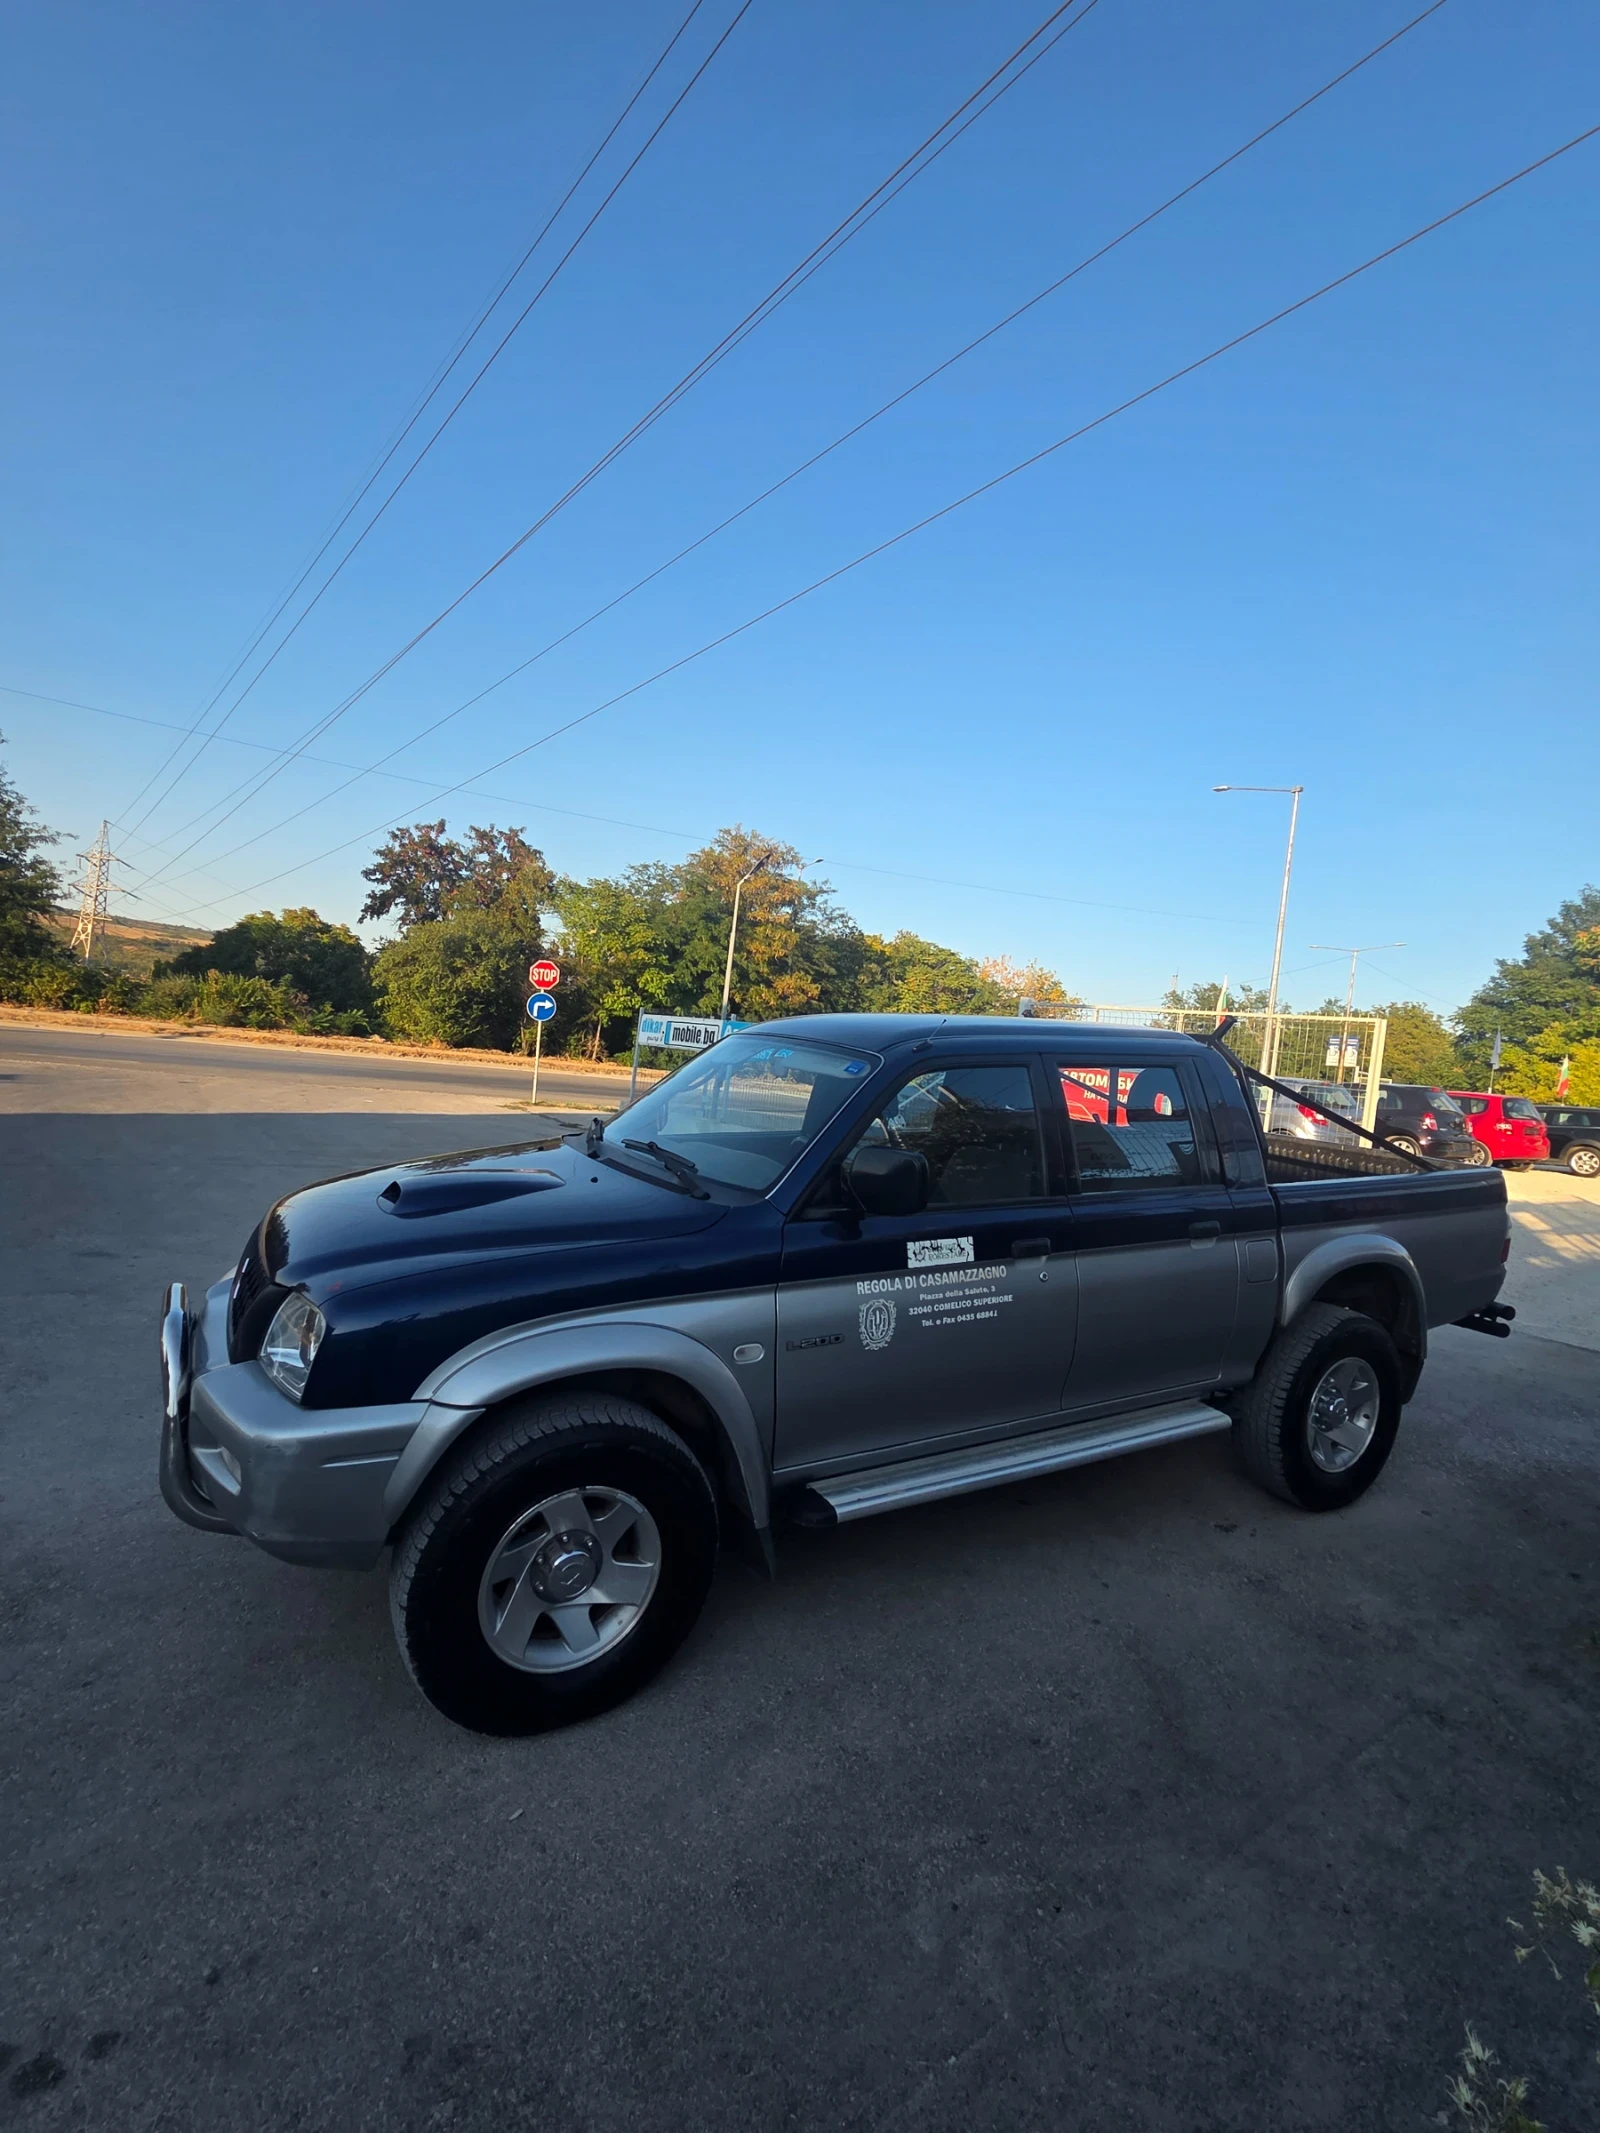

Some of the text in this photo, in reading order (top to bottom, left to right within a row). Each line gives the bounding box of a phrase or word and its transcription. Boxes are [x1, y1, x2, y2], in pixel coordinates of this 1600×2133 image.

[532, 968, 557, 982] STOP
[672, 1025, 716, 1045] mobile.bg
[856, 1265, 1007, 1295] REGOLA DI CASAMAZZAGNO
[919, 1291, 944, 1301] Piazza
[945, 1289, 964, 1299] della
[908, 1294, 1013, 1316] 32040 COMELICO SUPERIORE
[921, 1319, 935, 1327] Tel.
[942, 1316, 956, 1325] Fax
[957, 1313, 975, 1323] 0435
[786, 1333, 845, 1351] L200
